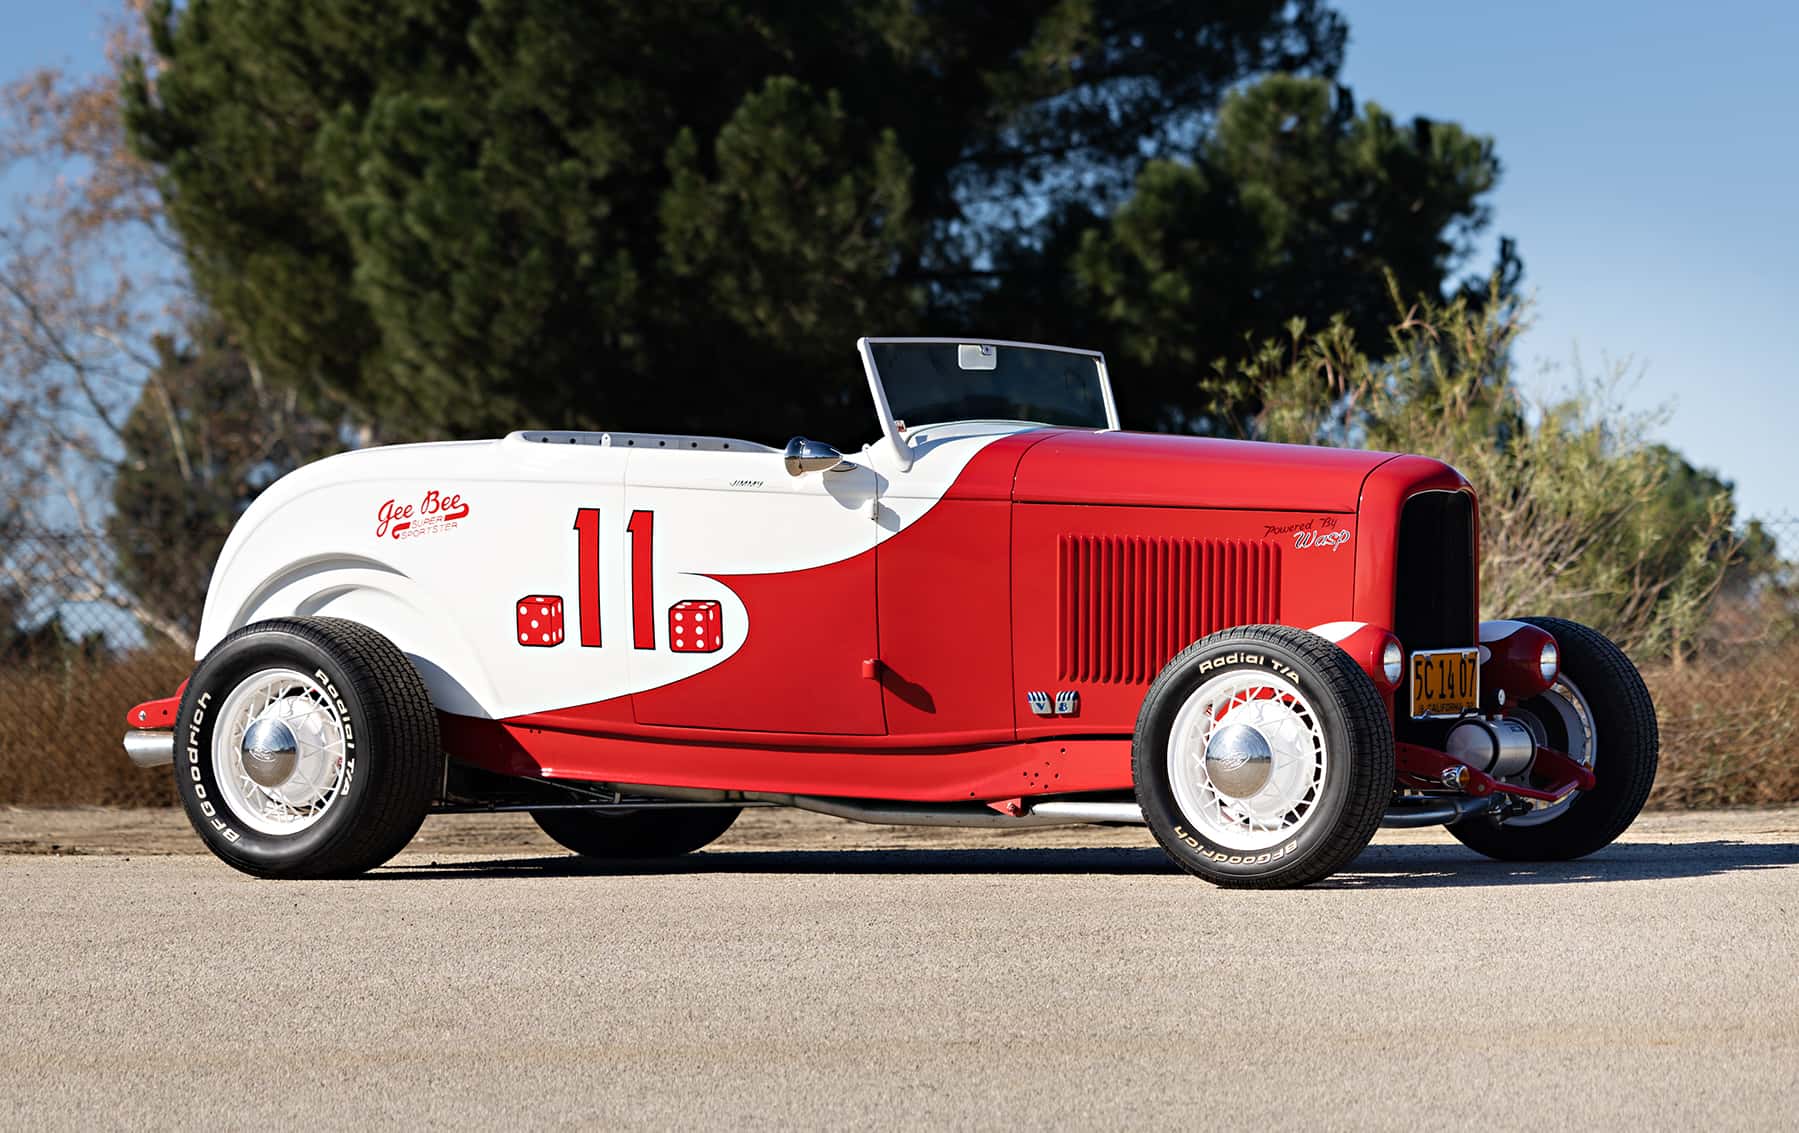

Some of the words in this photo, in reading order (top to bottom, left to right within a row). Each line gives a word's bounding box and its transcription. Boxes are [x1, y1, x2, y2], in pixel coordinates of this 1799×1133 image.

[376, 499, 414, 537] Gee
[421, 490, 464, 514] Bee
[401, 521, 458, 539] SPORTSTER
[412, 515, 443, 529] SUPER
[1263, 519, 1314, 537] Powered
[1320, 517, 1337, 529] By
[1293, 529, 1350, 552] Wasp
[573, 508, 656, 650] 11
[1199, 652, 1265, 674] Radial
[1271, 659, 1301, 685] T/A
[314, 669, 355, 749] Radial
[340, 757, 355, 797] T/A
[186, 691, 241, 843] BFGoodrich
[1174, 825, 1298, 865] BFGoodrich
